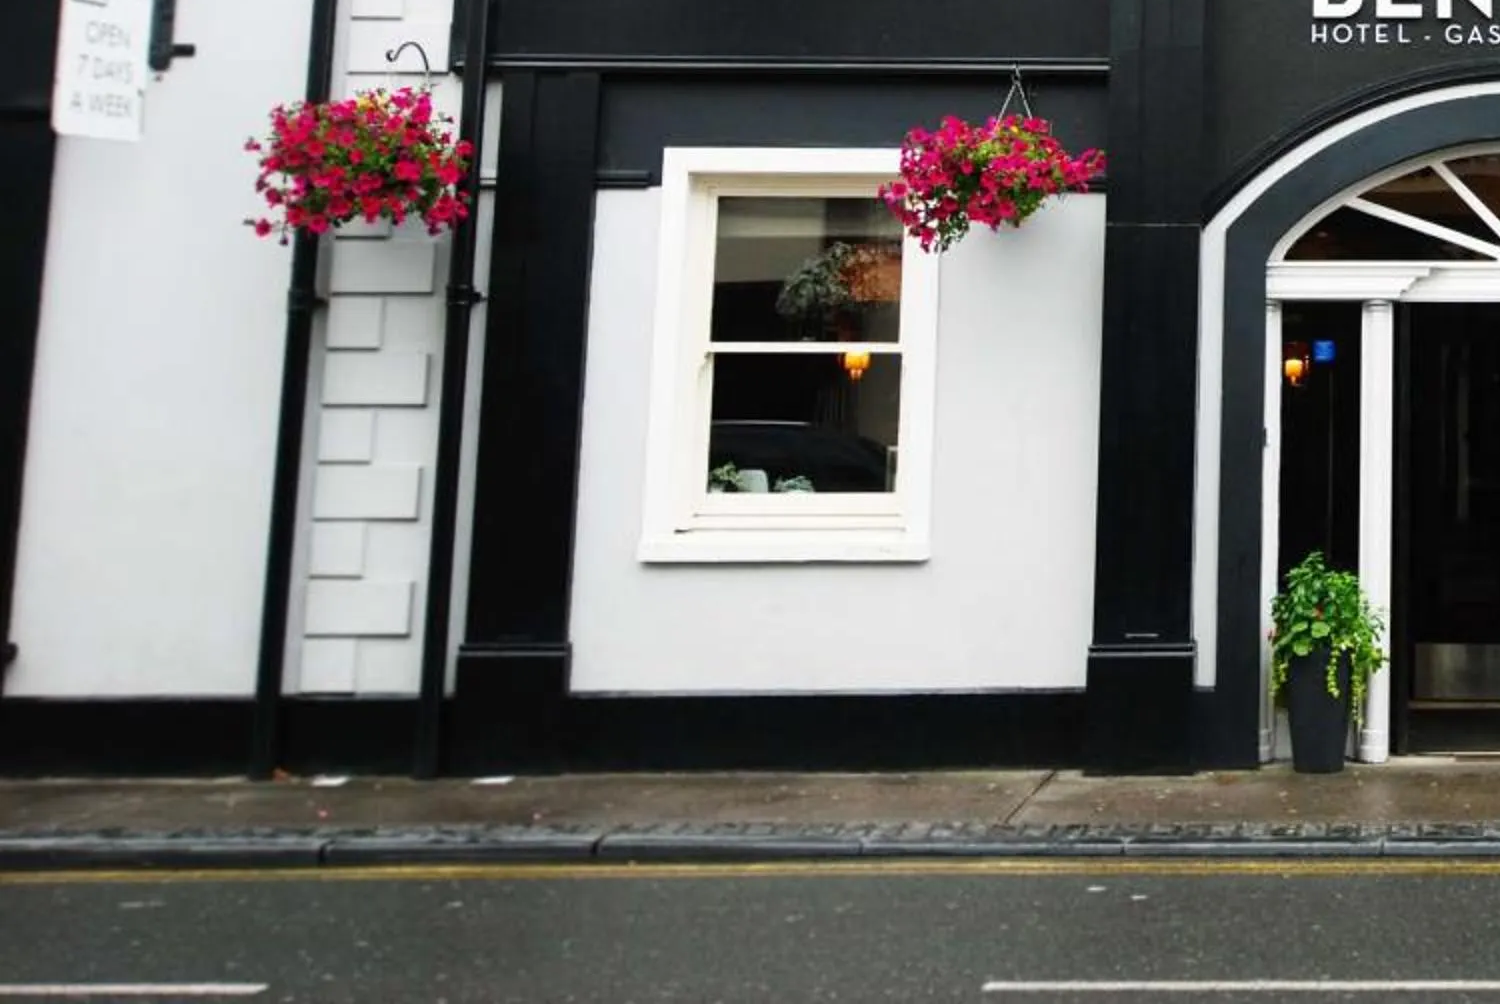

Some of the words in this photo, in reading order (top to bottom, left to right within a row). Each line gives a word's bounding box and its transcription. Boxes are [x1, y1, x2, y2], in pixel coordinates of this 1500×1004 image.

[85, 20, 131, 49] OPEN
[1310, 23, 1411, 44] HOTEL
[78, 53, 90, 76] 7
[92, 55, 133, 84] DAYS
[68, 89, 83, 113] A
[89, 93, 132, 117] WEEK
